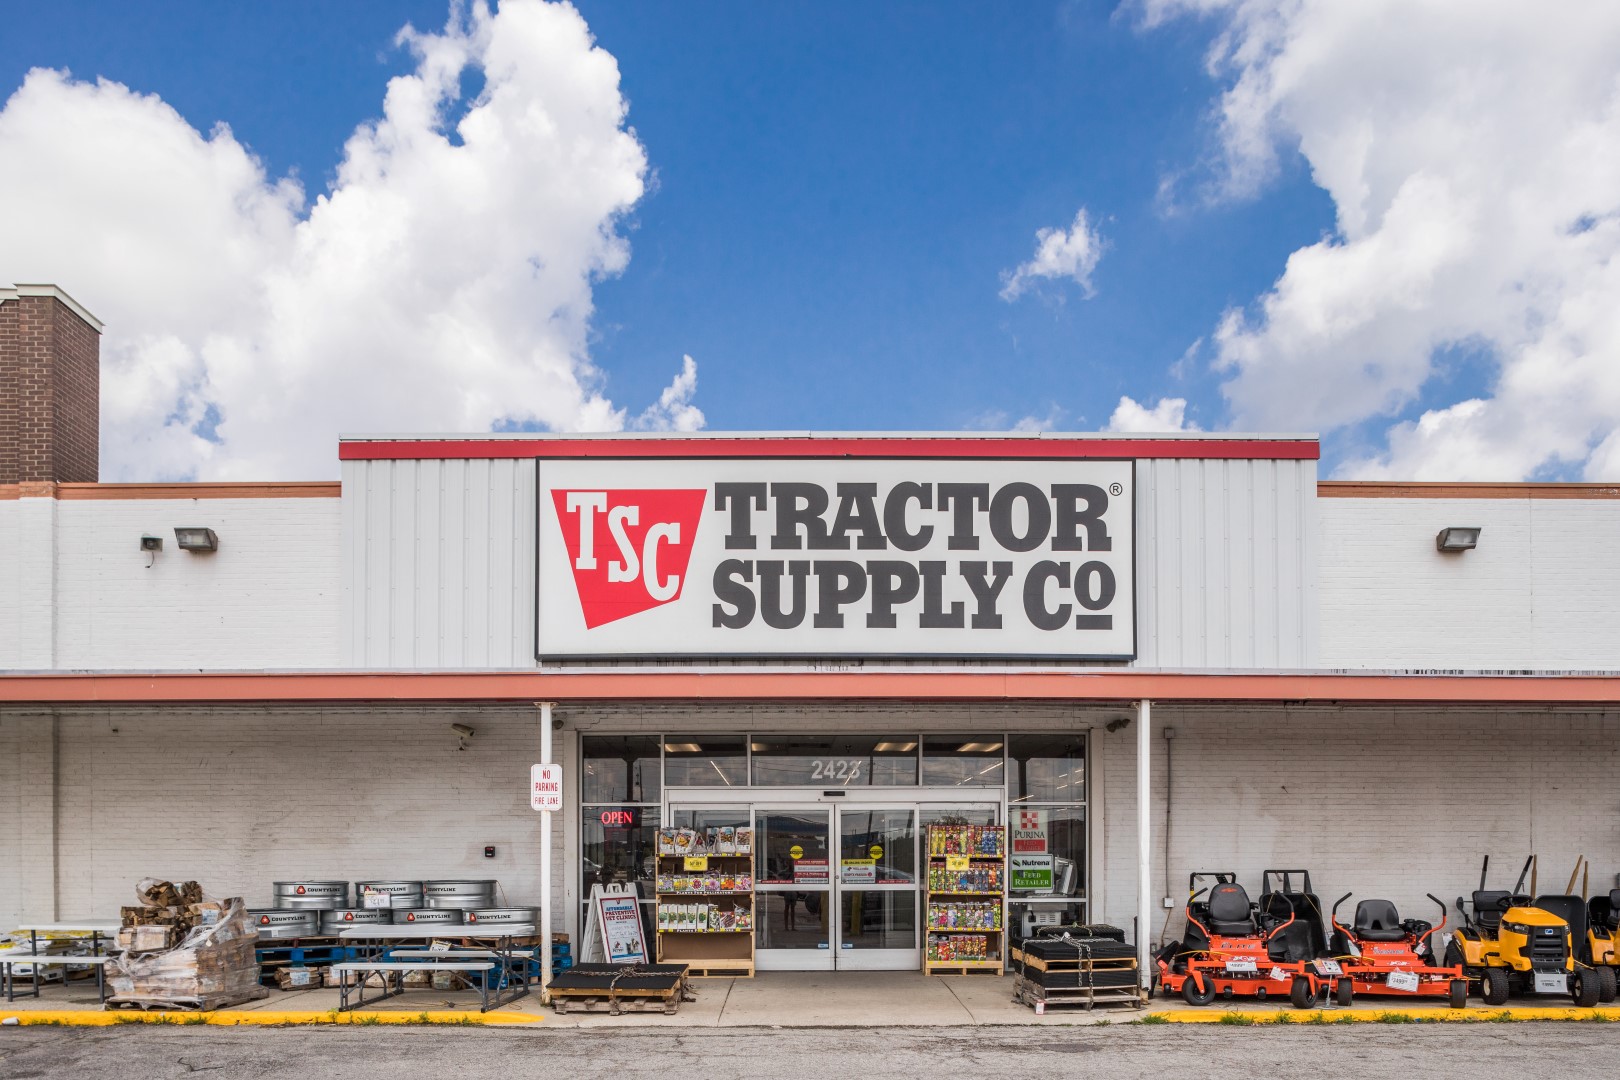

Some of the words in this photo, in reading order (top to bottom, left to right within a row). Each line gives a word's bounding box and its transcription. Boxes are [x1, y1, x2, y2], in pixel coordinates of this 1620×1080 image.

[714, 481, 1113, 552] TRACTOR
[566, 491, 682, 602] TSC
[711, 559, 1013, 631] SUPPLY
[542, 769, 551, 780] NO
[811, 760, 861, 780] 2423
[535, 782, 559, 792] PARKING
[534, 796, 545, 805] FIRE
[547, 796, 559, 805] LANE
[601, 811, 633, 825] OPEN
[1014, 829, 1045, 839] PURINA
[1023, 871, 1042, 879] FEED
[1014, 878, 1049, 886] RETAILER
